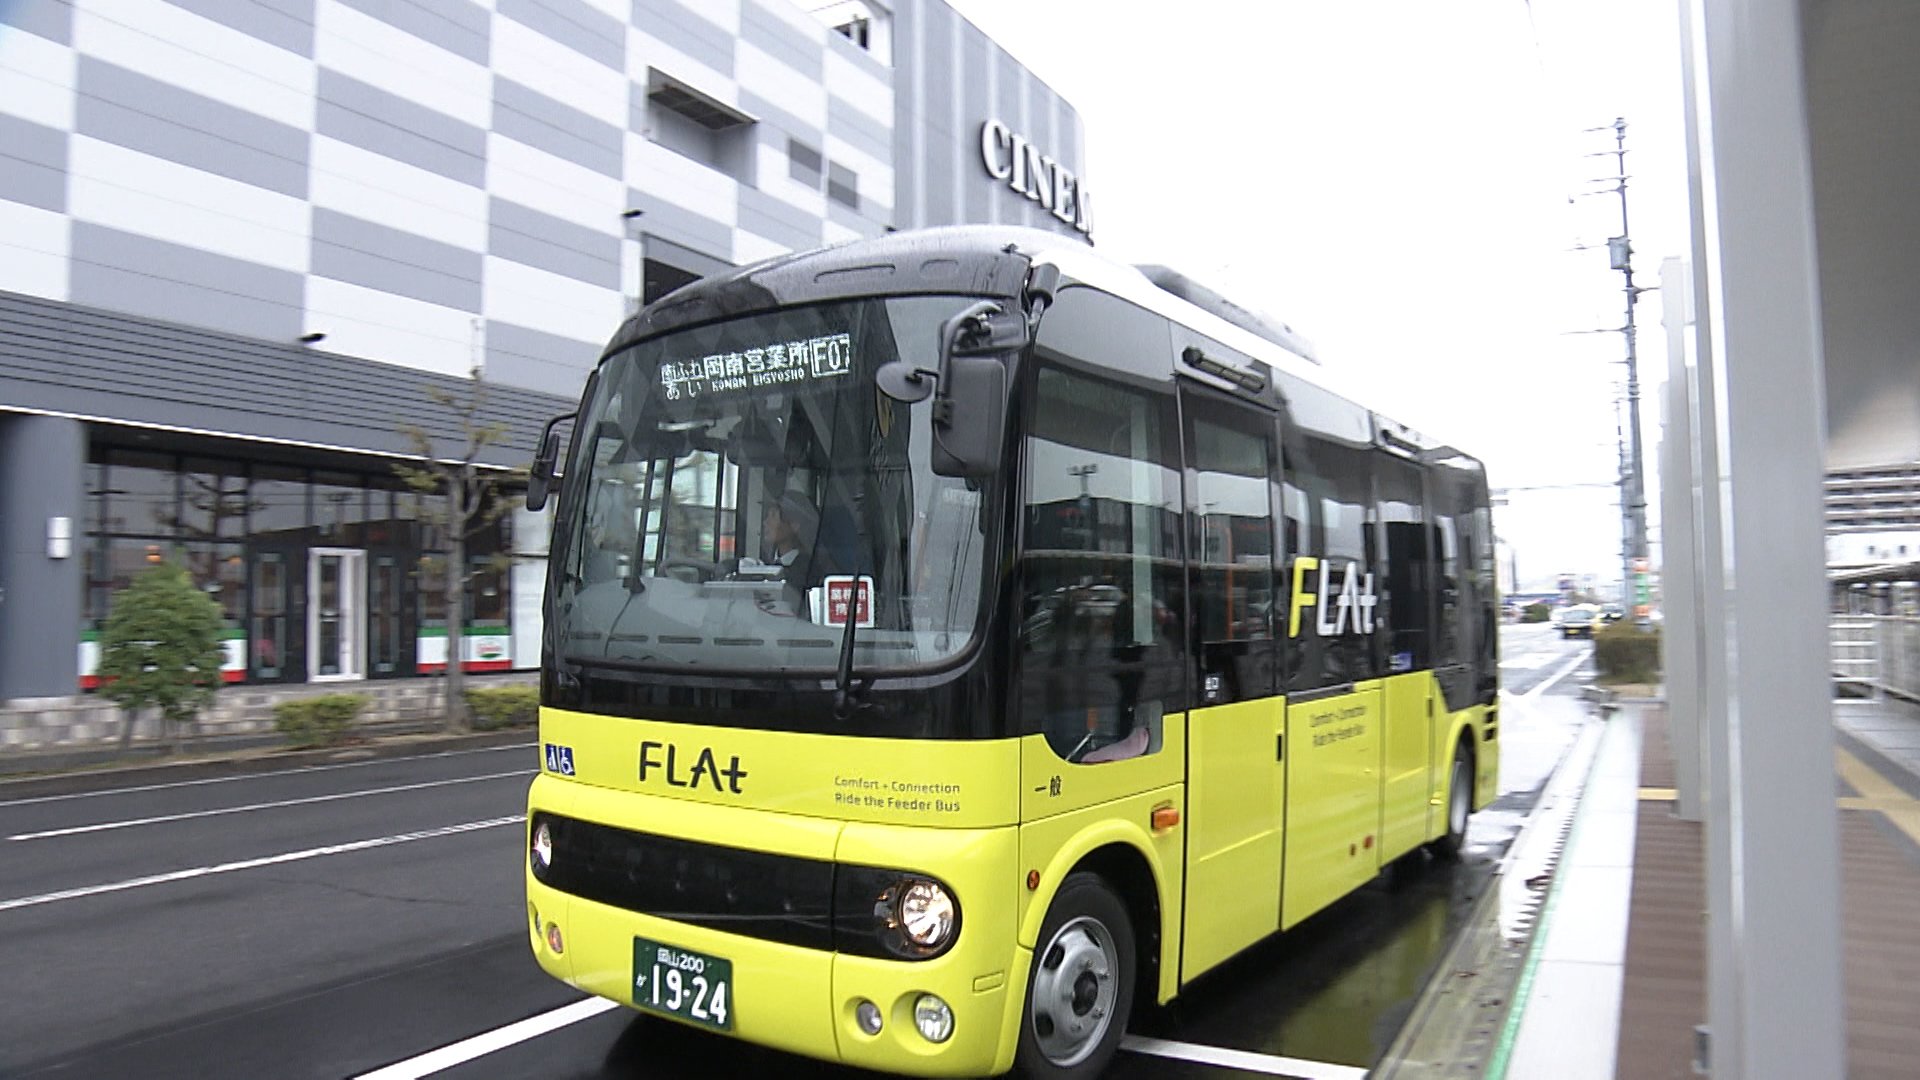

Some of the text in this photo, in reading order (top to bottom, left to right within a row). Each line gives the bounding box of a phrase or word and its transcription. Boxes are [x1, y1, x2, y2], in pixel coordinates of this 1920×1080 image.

[703, 341, 809, 380] 岡南営業所
[712, 376, 747, 392] KONAN
[834, 775, 879, 790] Comfort
[891, 781, 960, 794] Connection
[1034, 775, 1062, 798] 一般
[834, 793, 960, 812] Ride the Feeder Bus
